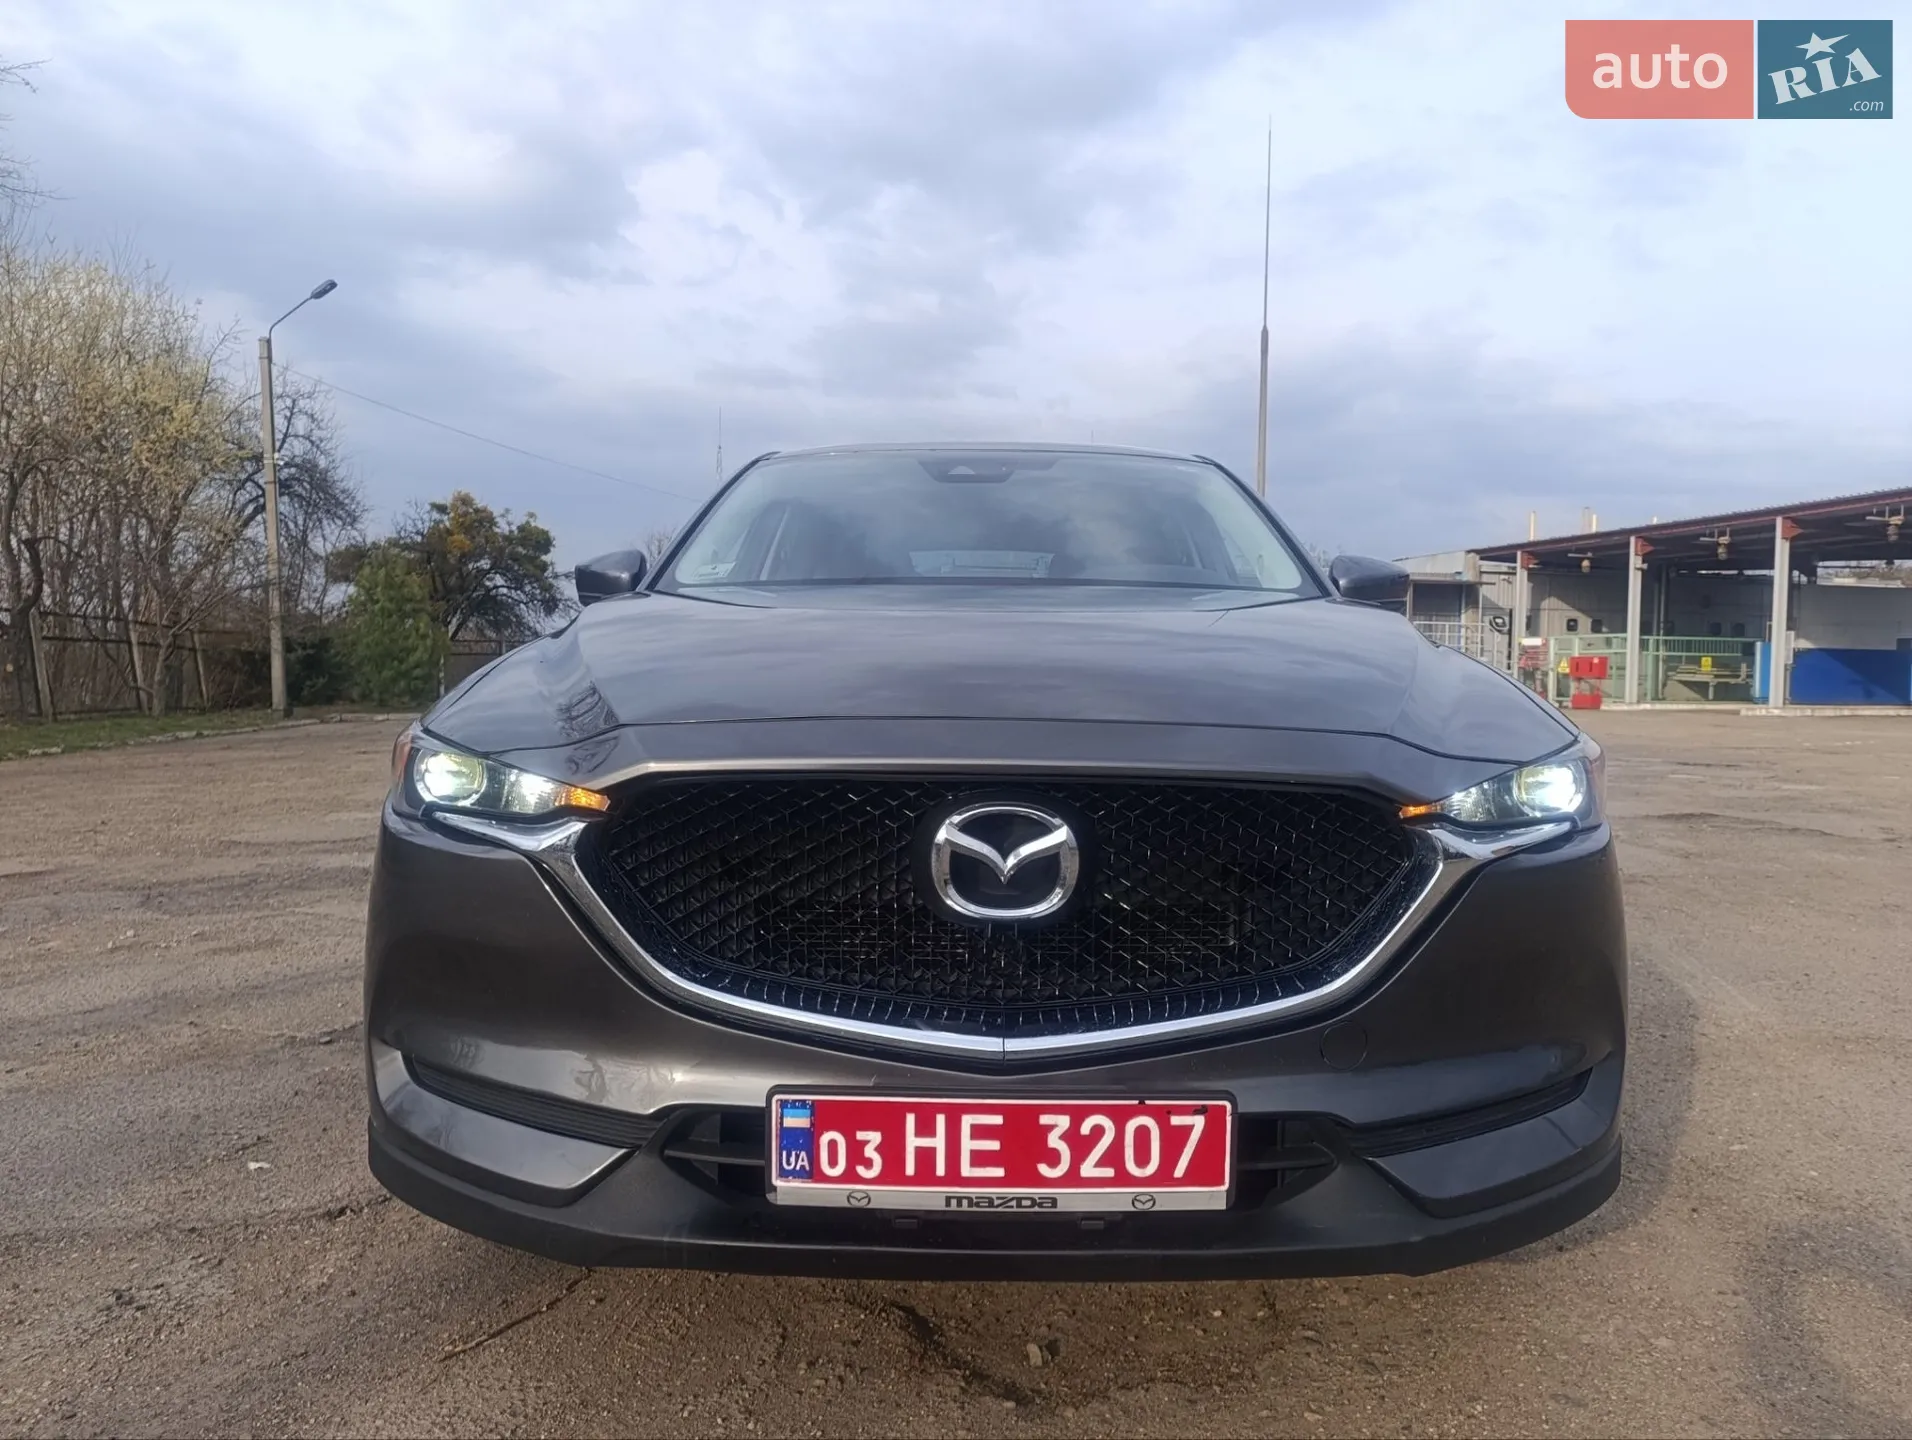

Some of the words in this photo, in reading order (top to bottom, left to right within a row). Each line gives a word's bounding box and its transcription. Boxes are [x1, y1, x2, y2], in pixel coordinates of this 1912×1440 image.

[818, 1130, 883, 1179] 03
[904, 1112, 1006, 1178] HE
[1036, 1114, 1206, 1178] 3207
[782, 1150, 810, 1171] UA
[944, 1194, 1058, 1210] mazda
